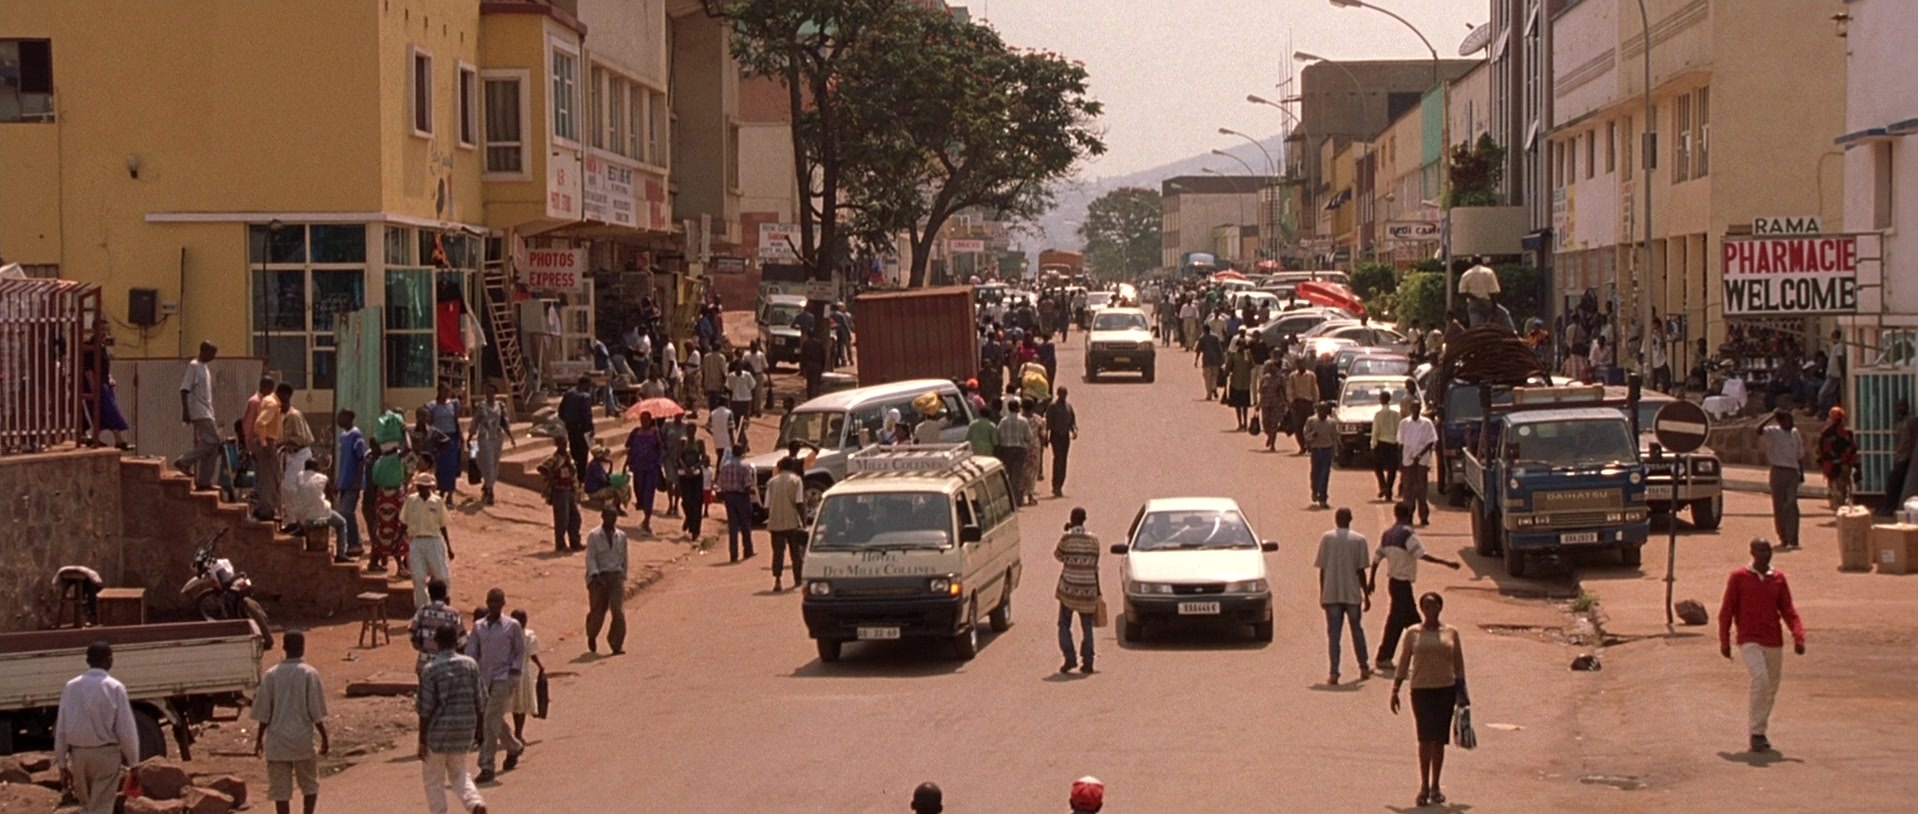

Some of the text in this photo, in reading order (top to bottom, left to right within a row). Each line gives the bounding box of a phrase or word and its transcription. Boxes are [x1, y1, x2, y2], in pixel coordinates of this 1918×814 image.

[1755, 218, 1820, 234] RAMA
[529, 252, 574, 267] PHOTOS
[1723, 239, 1856, 274] PHARMACIE
[529, 272, 575, 287] EXPRESS
[1723, 277, 1856, 312] WELCOME
[1546, 491, 1608, 500] DAIHATSU
[847, 565, 881, 576] MILLE
